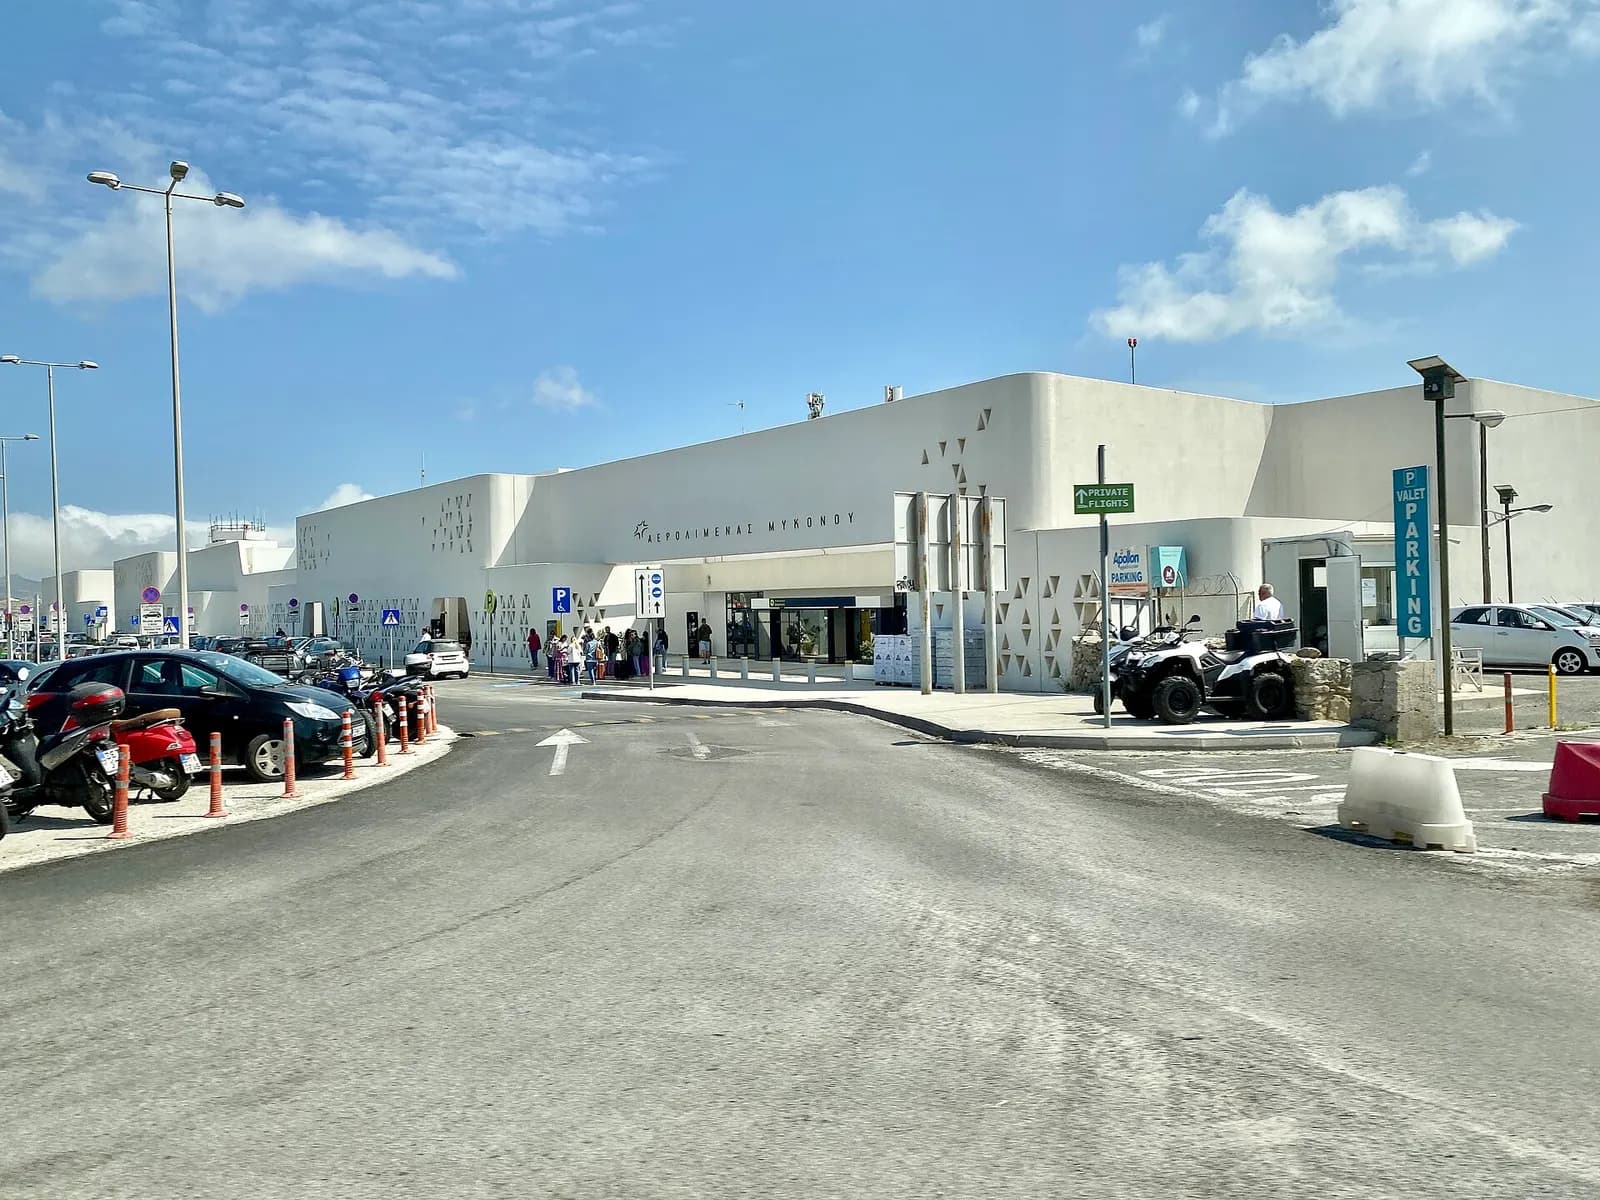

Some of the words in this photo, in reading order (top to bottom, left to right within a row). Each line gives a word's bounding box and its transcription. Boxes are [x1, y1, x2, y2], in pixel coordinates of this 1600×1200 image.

[1406, 472, 1415, 485] P
[1088, 488, 1129, 497] PRIVATE
[1397, 487, 1425, 501] VALET
[1088, 499, 1129, 508] FLIGHTS
[1113, 551, 1140, 567] Apollon
[1405, 502, 1421, 633] PARKING
[1111, 571, 1143, 583] PARKING
[487, 594, 493, 605] P
[556, 589, 566, 601] P
